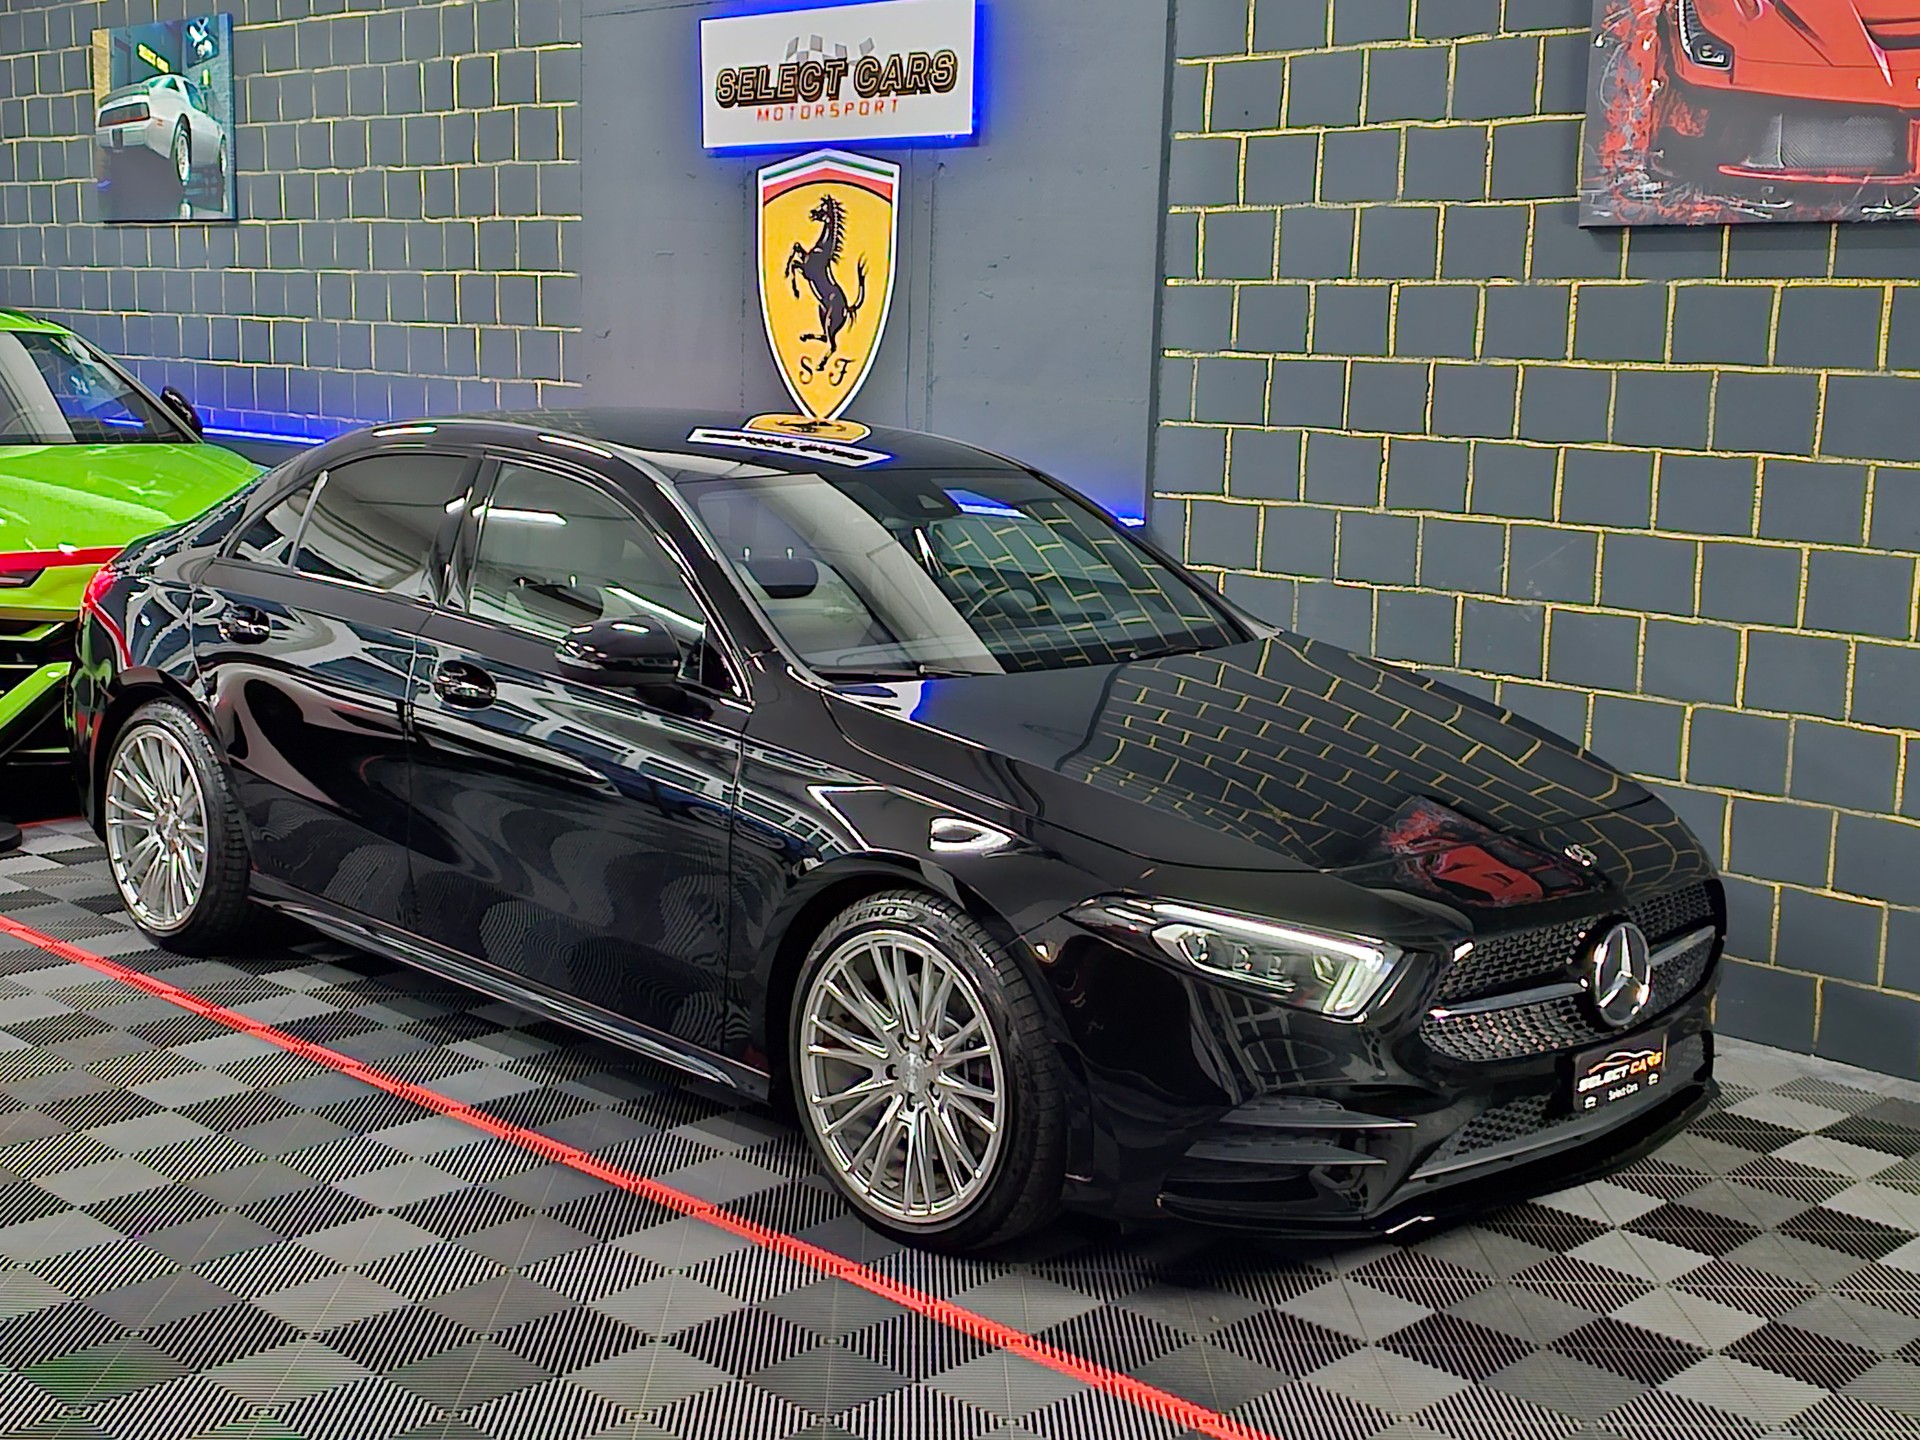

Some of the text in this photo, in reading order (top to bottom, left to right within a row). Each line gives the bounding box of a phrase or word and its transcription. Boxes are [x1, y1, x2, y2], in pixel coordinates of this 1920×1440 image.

[716, 49, 958, 108] SELECT CARS
[756, 99, 899, 121] MOTORSPORT
[799, 355, 814, 385] S
[844, 906, 898, 927] ZERO
[1577, 1051, 1663, 1092] SELECT CARS
